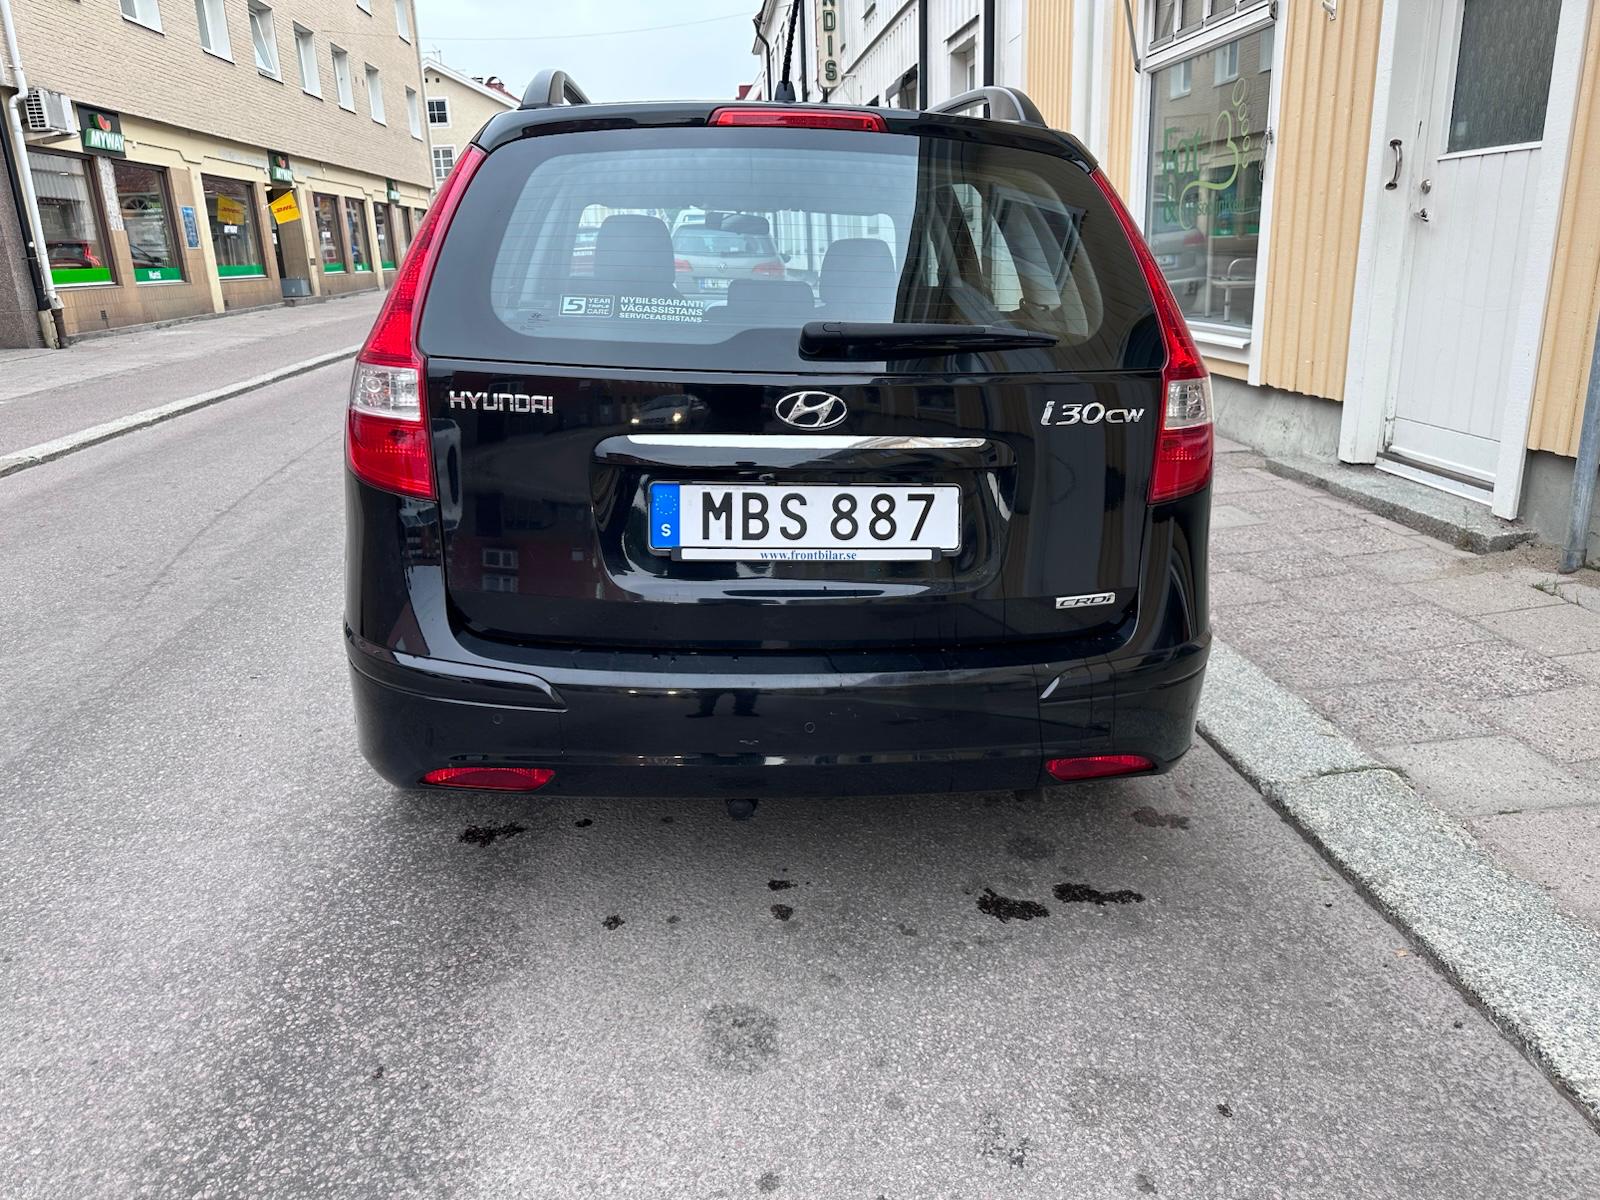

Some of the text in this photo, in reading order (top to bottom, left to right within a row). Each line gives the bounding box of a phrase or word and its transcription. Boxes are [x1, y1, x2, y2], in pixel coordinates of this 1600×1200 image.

[91, 129, 125, 152] MYWAY
[564, 298, 585, 312] 5
[588, 297, 611, 305] YEAR
[620, 296, 704, 308] NYBILSGARANTI
[620, 304, 703, 316] VÄGASSISTANS
[618, 312, 703, 323] SERVICEASSISTANS
[449, 390, 554, 415] HYUNDAI
[701, 491, 936, 541] MBS 887
[660, 523, 672, 537] S
[759, 549, 858, 561] www.frontbilar.se
[1060, 594, 1114, 607] CRDi
